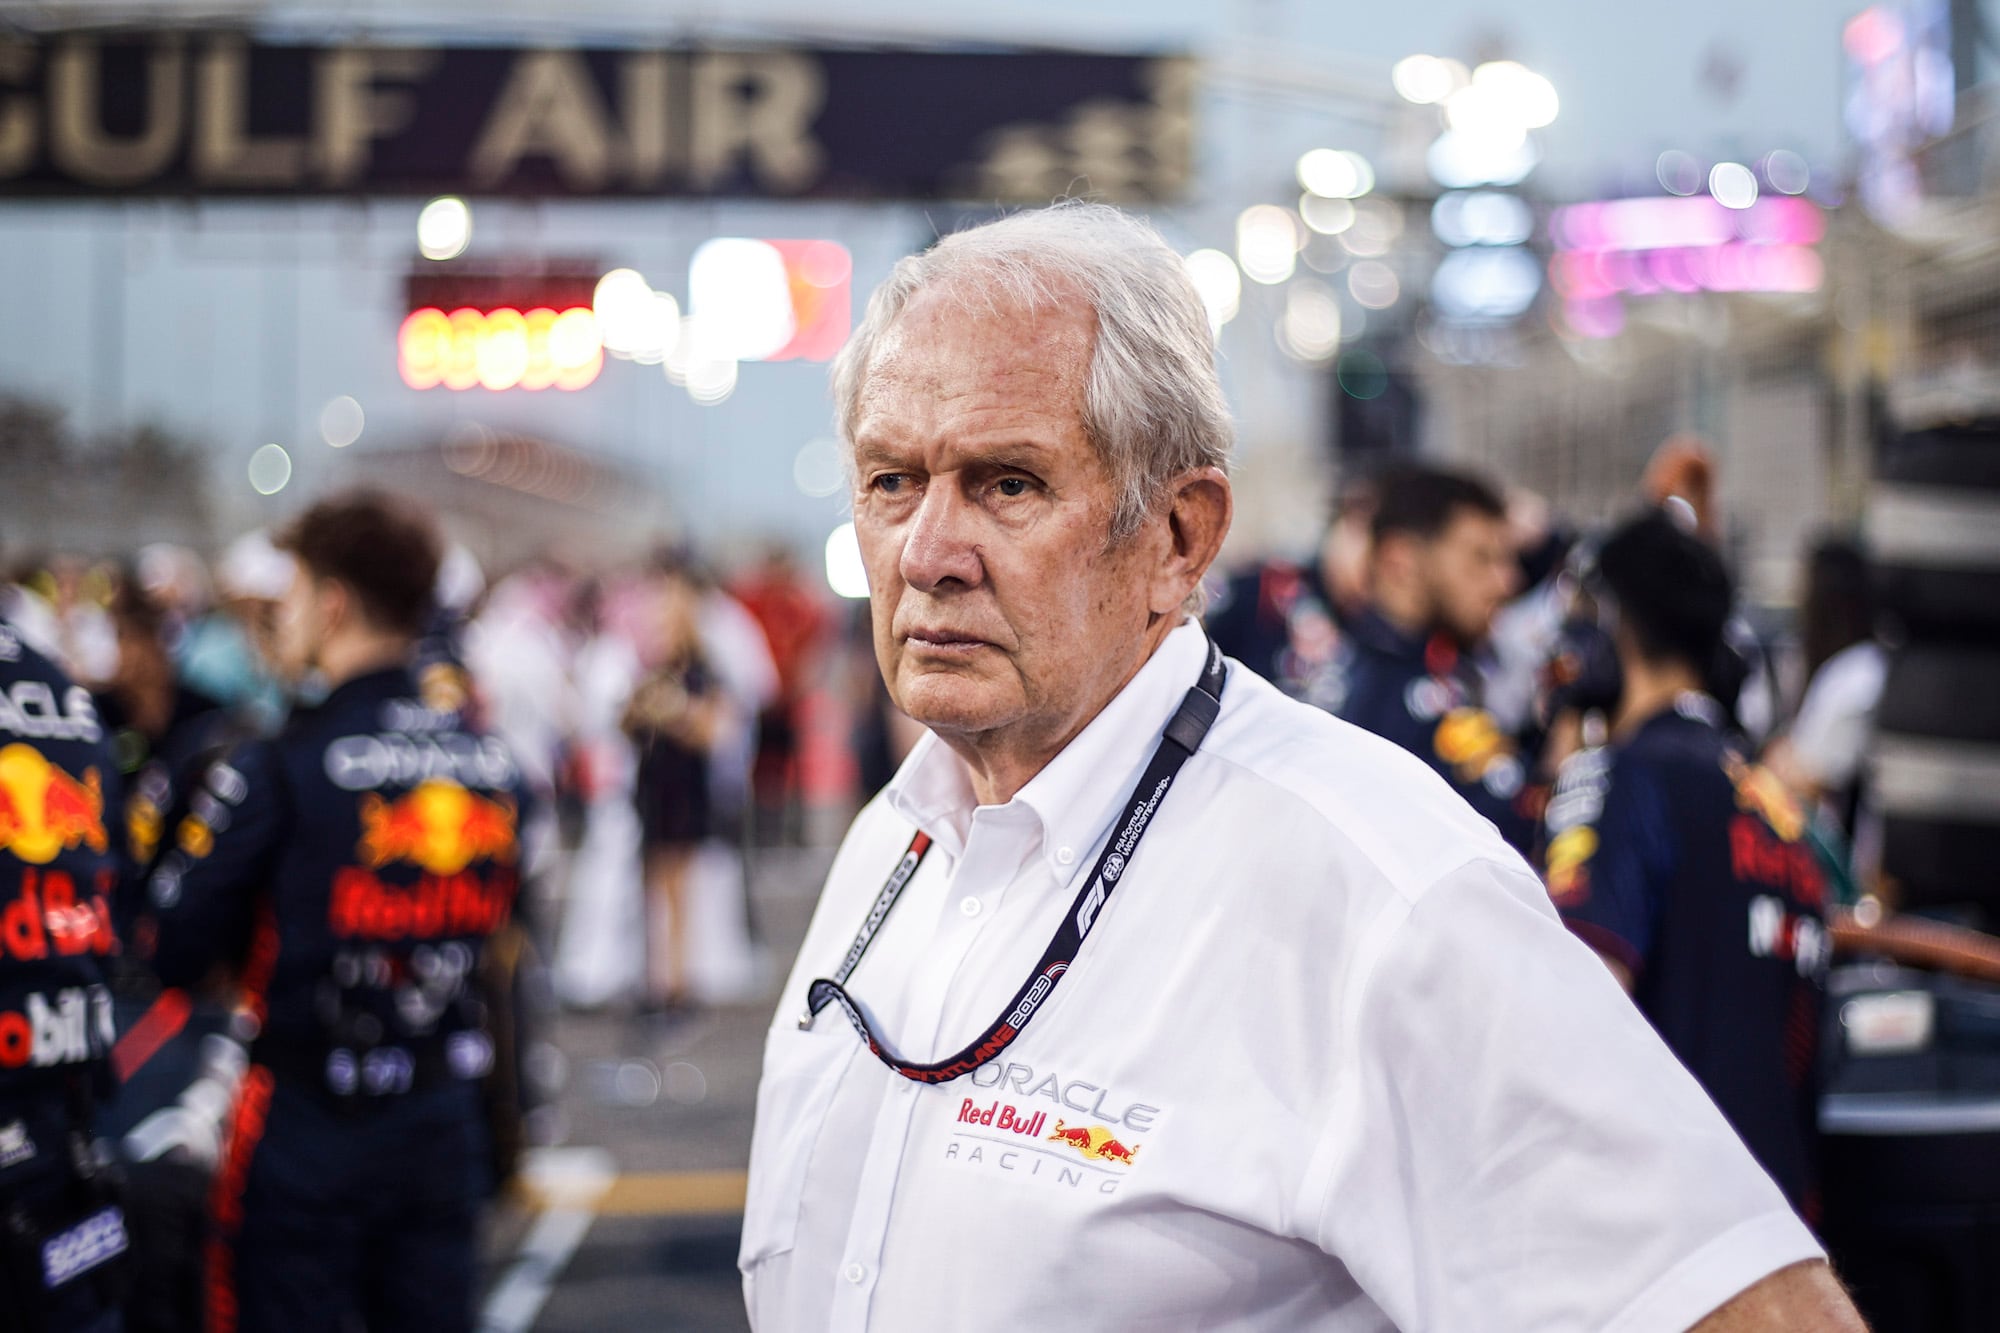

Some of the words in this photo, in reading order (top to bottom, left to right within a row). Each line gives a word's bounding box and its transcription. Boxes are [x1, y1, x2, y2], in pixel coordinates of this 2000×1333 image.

[465, 46, 828, 192] AIR
[1120, 804, 1145, 840] Formula
[1122, 829, 1140, 857] World
[1076, 873, 1106, 940] F1
[1006, 974, 1052, 1030] 2023
[957, 1097, 999, 1126] Red
[996, 1104, 1048, 1138] Bull
[971, 1060, 1160, 1133] ORACLE
[946, 1142, 1120, 1194] RACING
